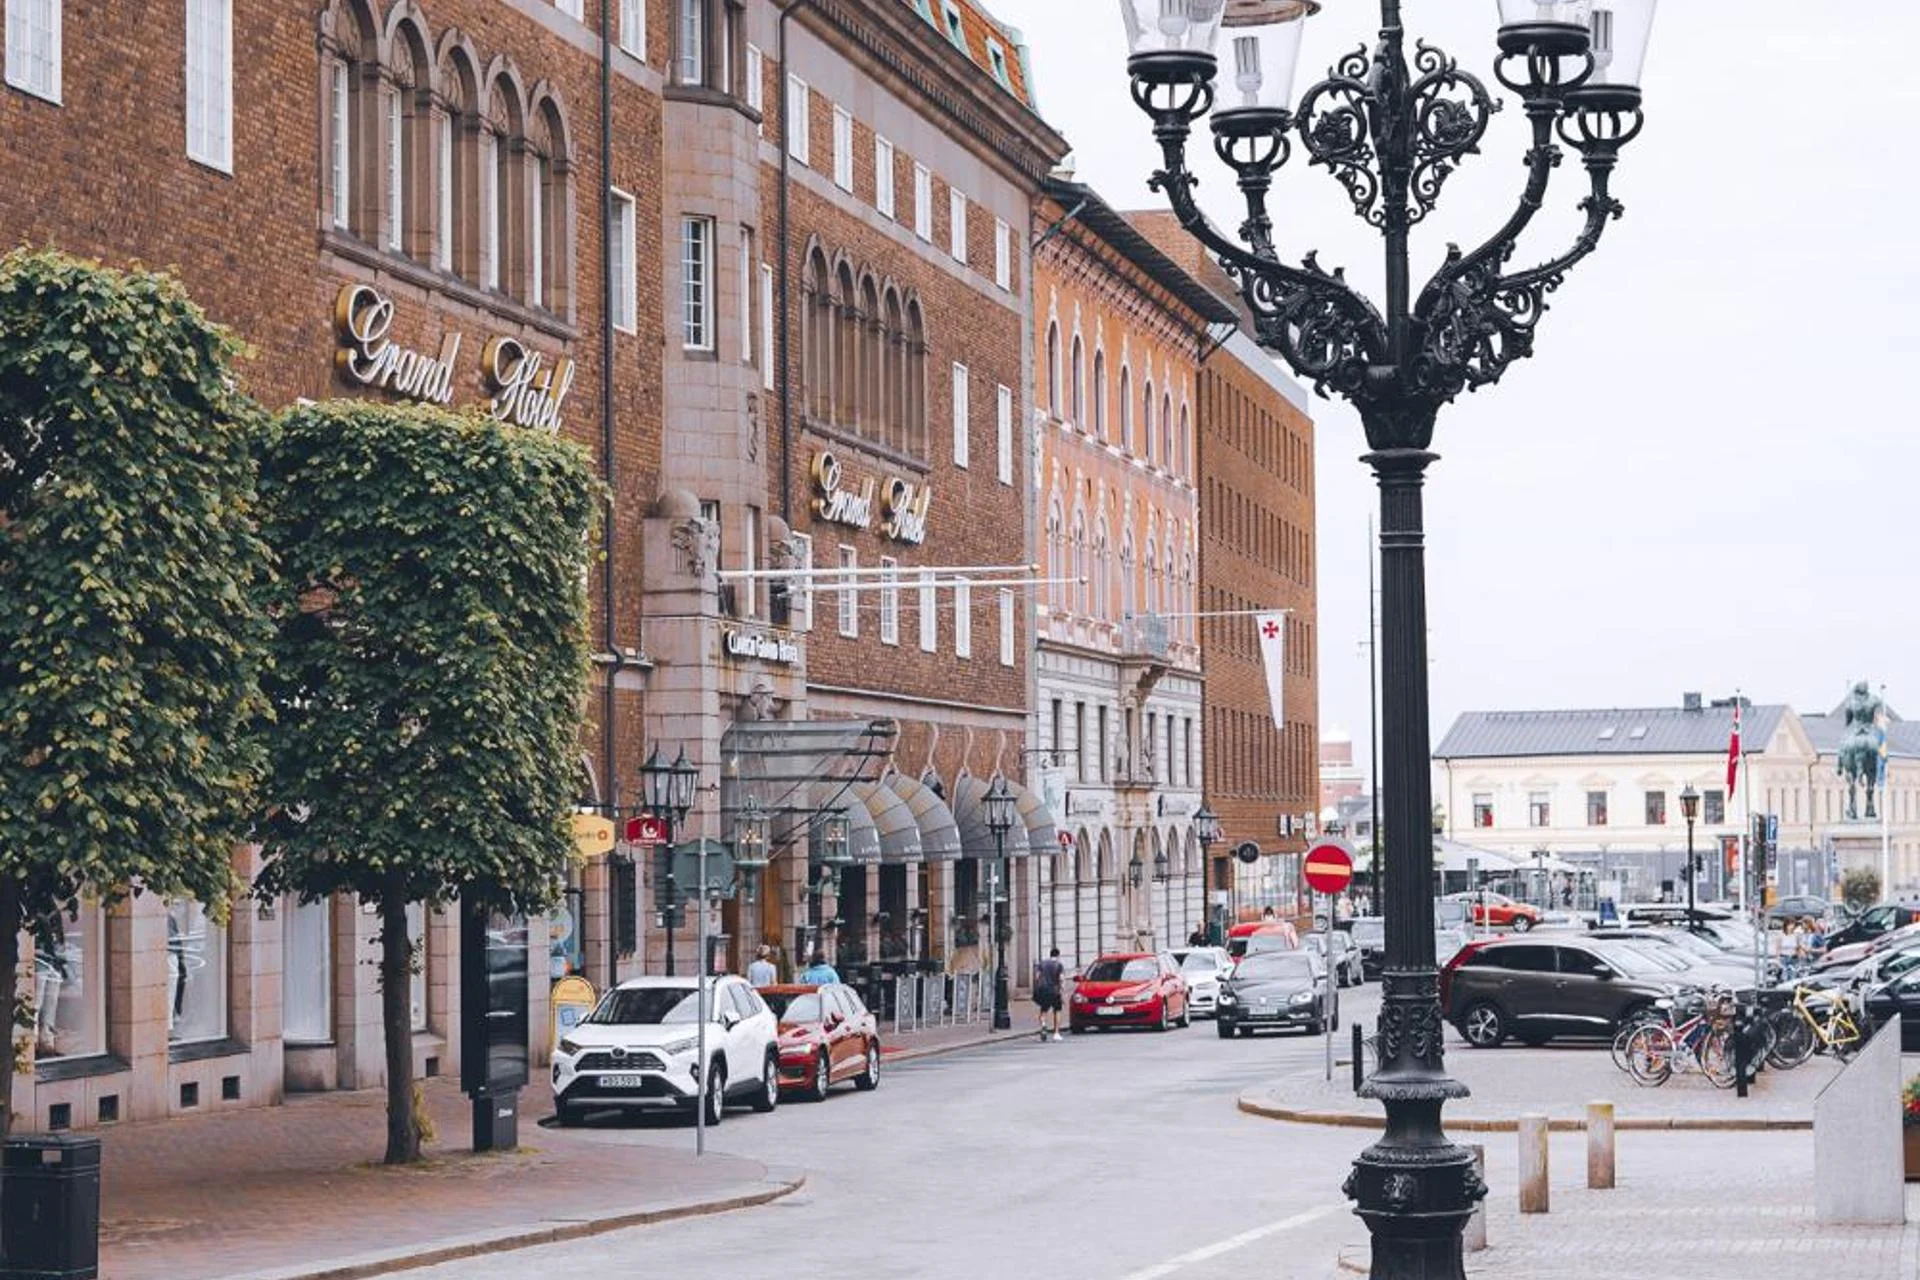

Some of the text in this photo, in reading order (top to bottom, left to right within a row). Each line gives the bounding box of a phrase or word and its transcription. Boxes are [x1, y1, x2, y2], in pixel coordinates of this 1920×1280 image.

[340, 285, 575, 433] Grand Hotel
[813, 452, 932, 544] Grand Hotel
